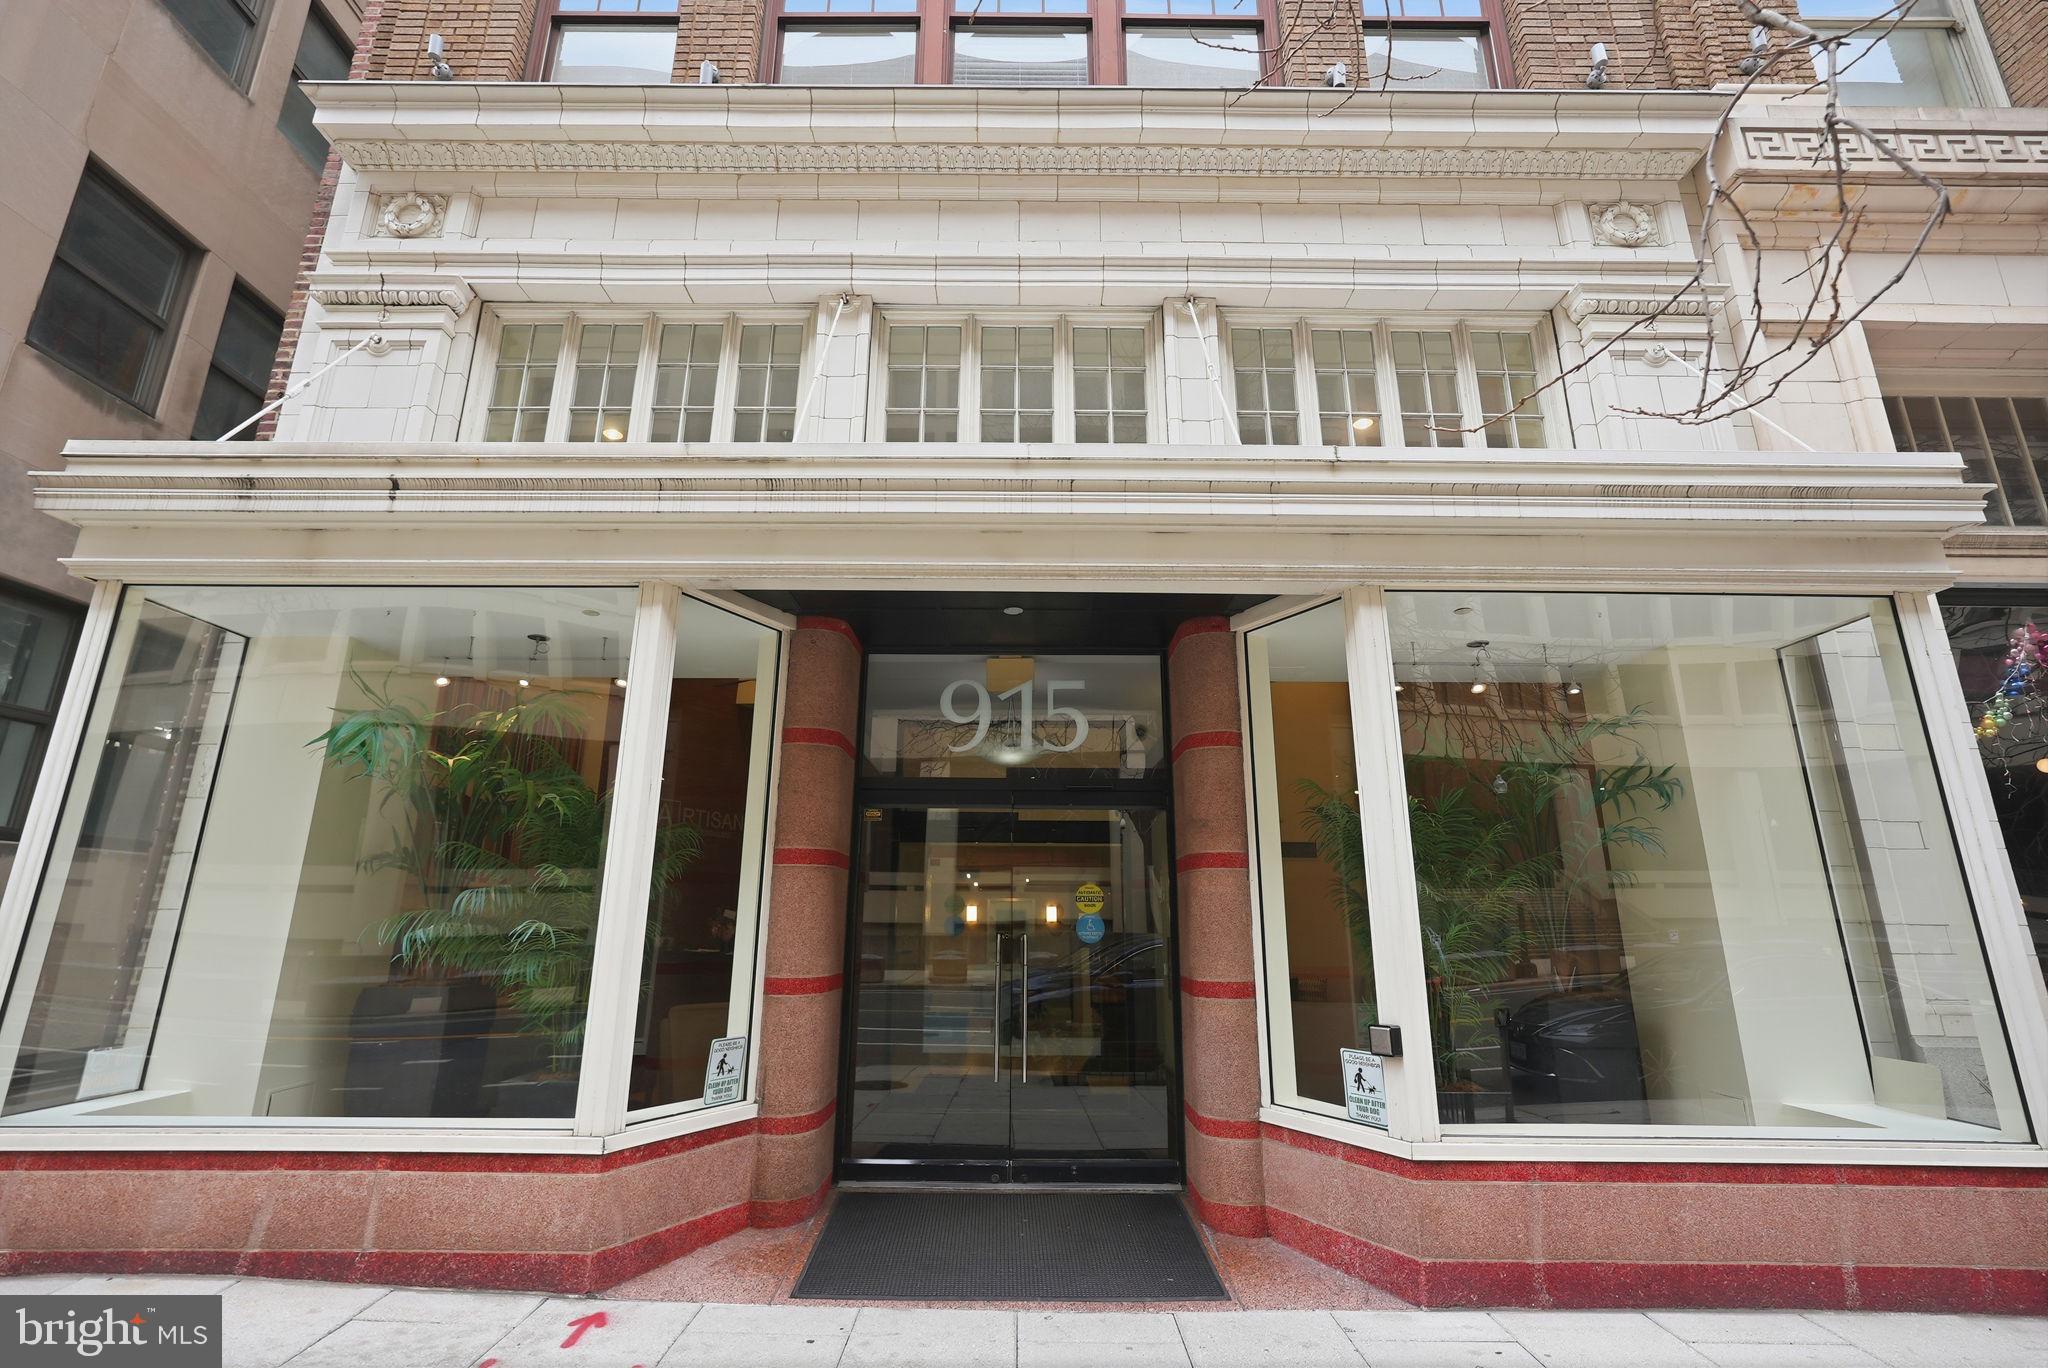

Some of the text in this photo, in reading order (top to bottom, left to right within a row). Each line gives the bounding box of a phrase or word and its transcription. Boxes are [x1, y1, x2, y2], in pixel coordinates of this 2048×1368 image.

[939, 679, 1089, 752] 915
[658, 801, 744, 833] ARTISAN
[1348, 1054, 1365, 1062] PLEASE
[1349, 1095, 1386, 1109] CLEAN UP AFTER
[1356, 1105, 1380, 1116] YOUR DOG
[1356, 1112, 1370, 1121] THANK
